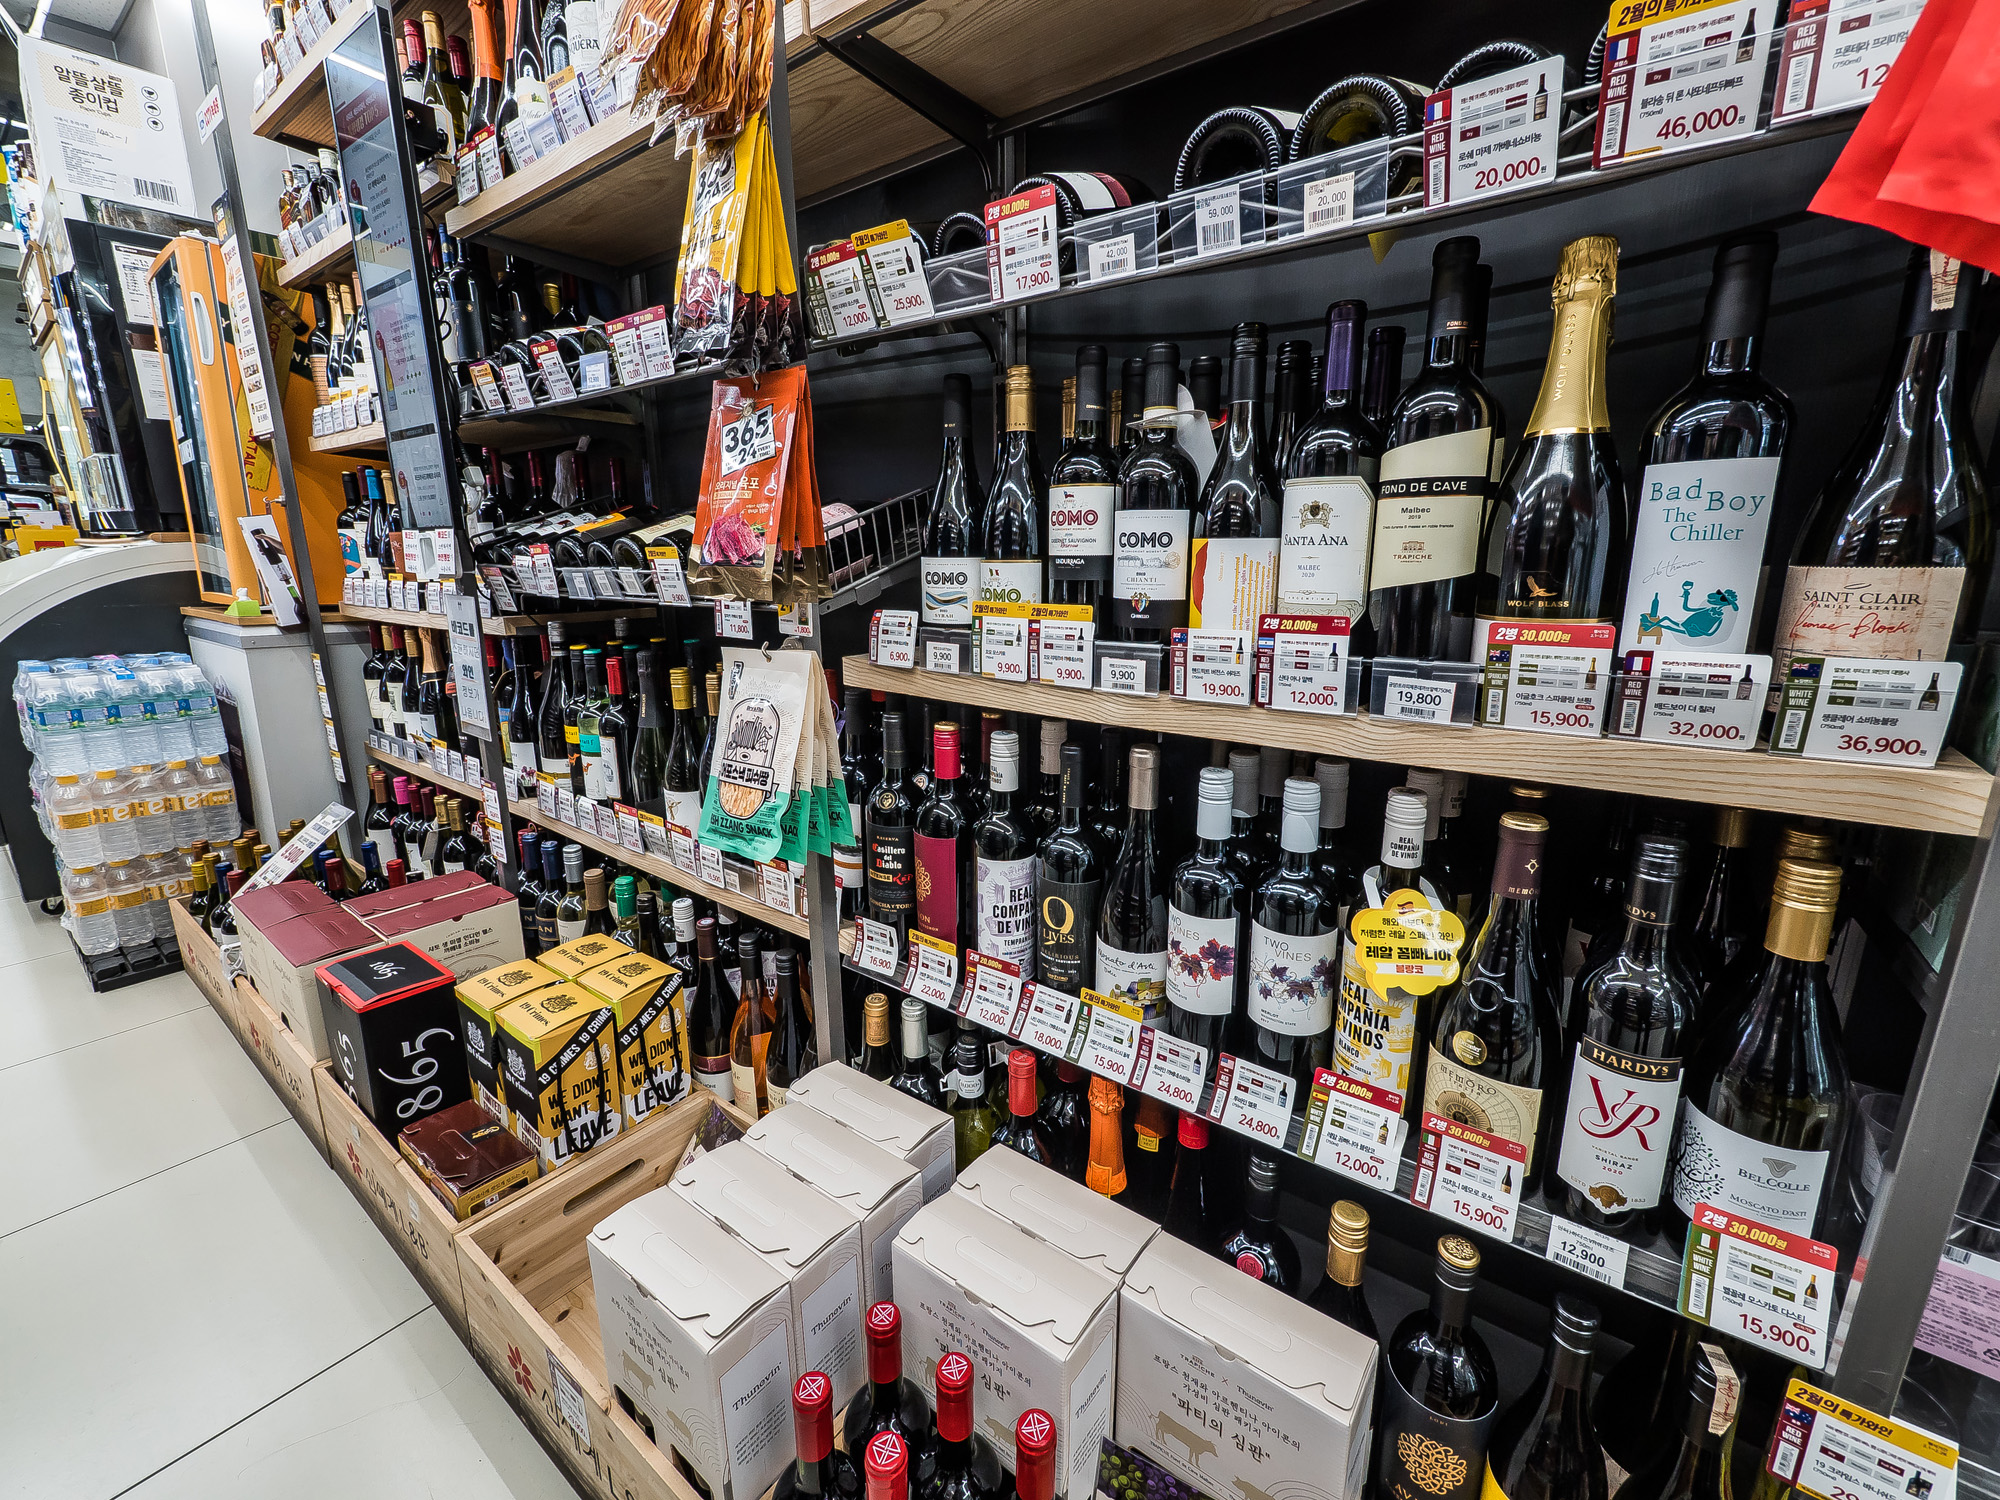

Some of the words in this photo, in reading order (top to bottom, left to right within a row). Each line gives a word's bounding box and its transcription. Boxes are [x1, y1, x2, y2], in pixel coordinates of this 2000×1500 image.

[1797, 24, 1816, 37] RED
[1792, 35, 1817, 51] WINE
[53, 65, 124, 98] 알뜰살뜰
[1610, 74, 1626, 86] RED
[1607, 85, 1627, 99] WINE
[68, 86, 119, 114] 종이컵
[1639, 108, 1663, 119] (750ml)
[1431, 133, 1444, 145] RED
[1429, 141, 1446, 154] WINE
[987, 208, 1000, 224] 2병
[1001, 199, 1030, 216] 30,000원
[1553, 363, 1566, 402] WOLF
[1564, 313, 1576, 356] BLASS
[1381, 482, 1406, 494] FOND
[1410, 482, 1427, 492] DE
[1432, 481, 1467, 492] CAVE
[1650, 480, 1702, 508] Bad
[1704, 490, 1766, 524] Boy
[1051, 510, 1099, 526] COMO
[1663, 508, 1697, 523] The
[1119, 532, 1173, 548] COMO
[1284, 533, 1315, 546] SANTA
[1317, 533, 1348, 546] ANA
[1670, 523, 1744, 549] Chiller
[925, 572, 968, 585] COMO
[981, 588, 1021, 603] COMO
[1803, 590, 1855, 604] SAINT
[1859, 590, 1922, 605] CLAIR
[974, 605, 989, 614] 2월의
[1507, 600, 1534, 608] WOLF
[1538, 600, 1569, 608] BLASS
[1031, 607, 1048, 617] 2월의
[450, 620, 476, 638] 바코드를
[1263, 618, 1280, 629] 2병
[1280, 619, 1318, 631] 20,000원
[1495, 628, 1518, 640] 2병
[1520, 630, 1571, 643] 30,000원
[933, 651, 951, 662] 9,900
[461, 664, 475, 679] 와인
[1110, 669, 1135, 681] 9,900
[1625, 688, 1642, 696] WINE
[1628, 681, 1642, 689] RED
[1397, 691, 1442, 709] 19,800
[1545, 695, 1575, 703] 스파클링
[1789, 689, 1813, 699] WHITE
[1686, 704, 1696, 712] 더
[1697, 704, 1716, 714] 칠러
[1788, 698, 1813, 707] WINE
[719, 821, 744, 833] ZZANG
[746, 824, 773, 839] SNACK
[872, 843, 905, 854] Casillero
[1400, 851, 1418, 859] VINOS
[876, 858, 902, 870] Diablo
[1009, 886, 1033, 901] REAL
[997, 921, 1011, 933] DE
[1043, 930, 1074, 946] LIVES
[1360, 929, 1386, 938] 저렴한
[1438, 931, 1454, 941] 와인
[1264, 936, 1288, 951] TWO
[1275, 950, 1312, 962] VINES
[1366, 946, 1393, 959] 레알
[1397, 947, 1452, 961] 꼼빠니아
[369, 962, 405, 980] 1865
[1396, 964, 1423, 974] 블랑코
[477, 977, 484, 985] 19
[483, 981, 506, 998] Crimes
[1084, 992, 1101, 1004] 2월의
[519, 1002, 527, 1010] 19
[525, 1005, 551, 1027] Crimes
[620, 1036, 631, 1045] 19
[654, 996, 665, 1007] 19
[1339, 1038, 1360, 1058] BLANCO
[538, 1073, 551, 1085] 19
[579, 1032, 590, 1044] 19
[1319, 1073, 1336, 1086] 2병
[1336, 1080, 1373, 1100] 20,000원
[520, 1121, 542, 1148] LIMITED
[1428, 1118, 1447, 1132] 2병
[1448, 1125, 1490, 1148] 30,000원
[1595, 1154, 1633, 1171] SHIRAZ
[1602, 1165, 1623, 1176] 2020
[1730, 1193, 1780, 1214] MOSCATO
[1782, 1209, 1807, 1218] D'ASTI
[401, 1211, 428, 1260] L&B
[1700, 1210, 1727, 1229] 2병
[1729, 1221, 1788, 1250] 30,000원
[1560, 1240, 1605, 1268] 12,900
[1693, 1253, 1713, 1268] WHITE
[1693, 1262, 1711, 1274] WINE
[1748, 1293, 1778, 1313] 모스카토
[1781, 1306, 1806, 1323] 다스티
[1180, 1354, 1215, 1378] TRAPICHE
[1153, 1354, 1179, 1375] 프랑스
[1182, 1371, 1208, 1393] 천재와
[1211, 1389, 1259, 1424] 아르헨티나
[1262, 1422, 1301, 1451] 아이콘의
[1182, 1383, 1208, 1405] 가성비
[1213, 1402, 1230, 1418] 심판
[1234, 1415, 1262, 1438] 패키지
[1794, 1387, 1840, 1414] 2월의
[1840, 1409, 1894, 1438] 특가와인
[1782, 1431, 1802, 1446] WINE
[1786, 1426, 1802, 1438] RED
[1814, 1459, 1826, 1470] 19
